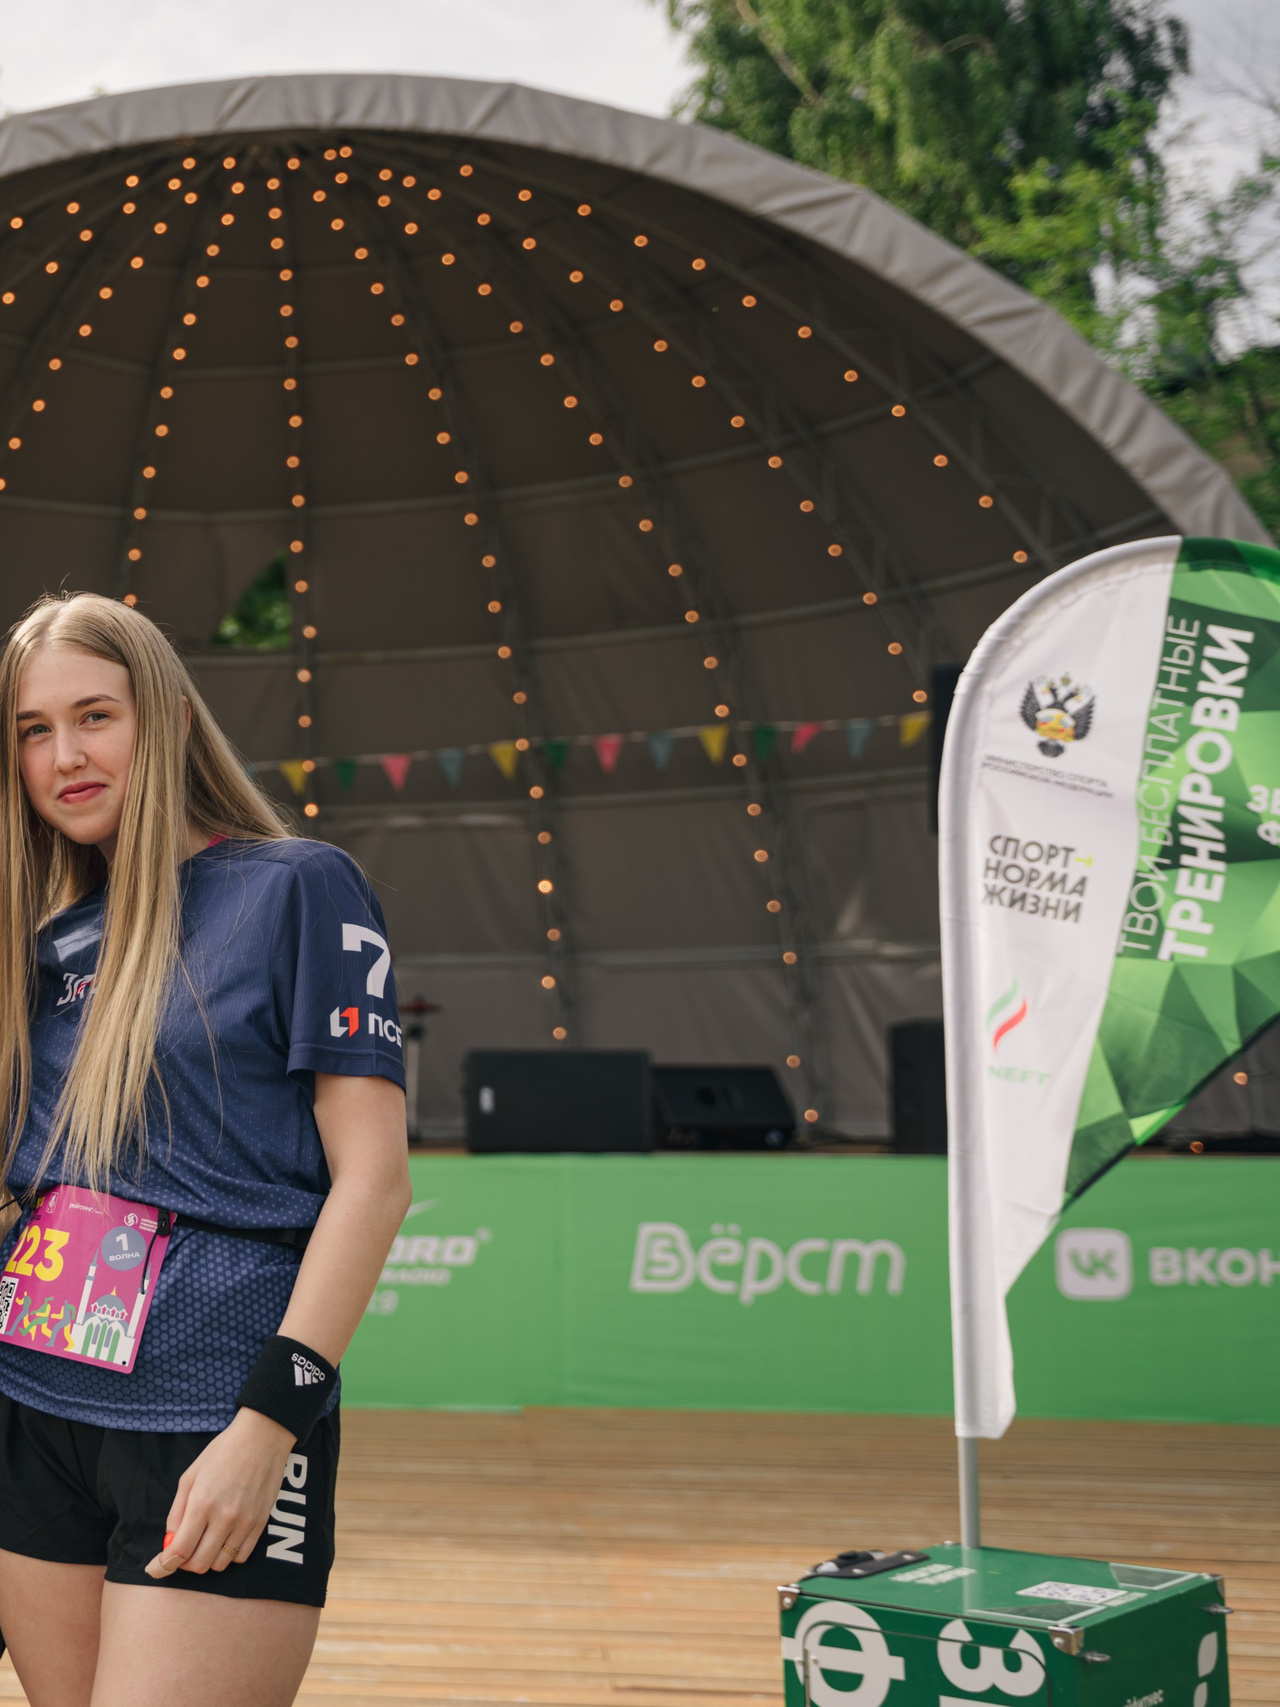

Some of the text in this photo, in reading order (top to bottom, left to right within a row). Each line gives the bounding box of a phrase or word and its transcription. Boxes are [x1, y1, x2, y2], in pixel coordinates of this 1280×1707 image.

[1136, 614, 1201, 848] БЕСПЛАТНЫЕ
[1156, 623, 1255, 961] ТРЕНИРОВКИ
[989, 834, 1076, 869] СПОРТ
[983, 857, 1089, 898] НОРМА
[980, 882, 1083, 923] ЖИЗНИ
[342, 922, 391, 999] 7
[986, 1065, 1051, 1086] NEFT
[109, 1251, 141, 1263] ВОЛНА
[115, 1233, 129, 1251] 1
[291, 1352, 325, 1382] adidas
[266, 1453, 308, 1565] RUN
